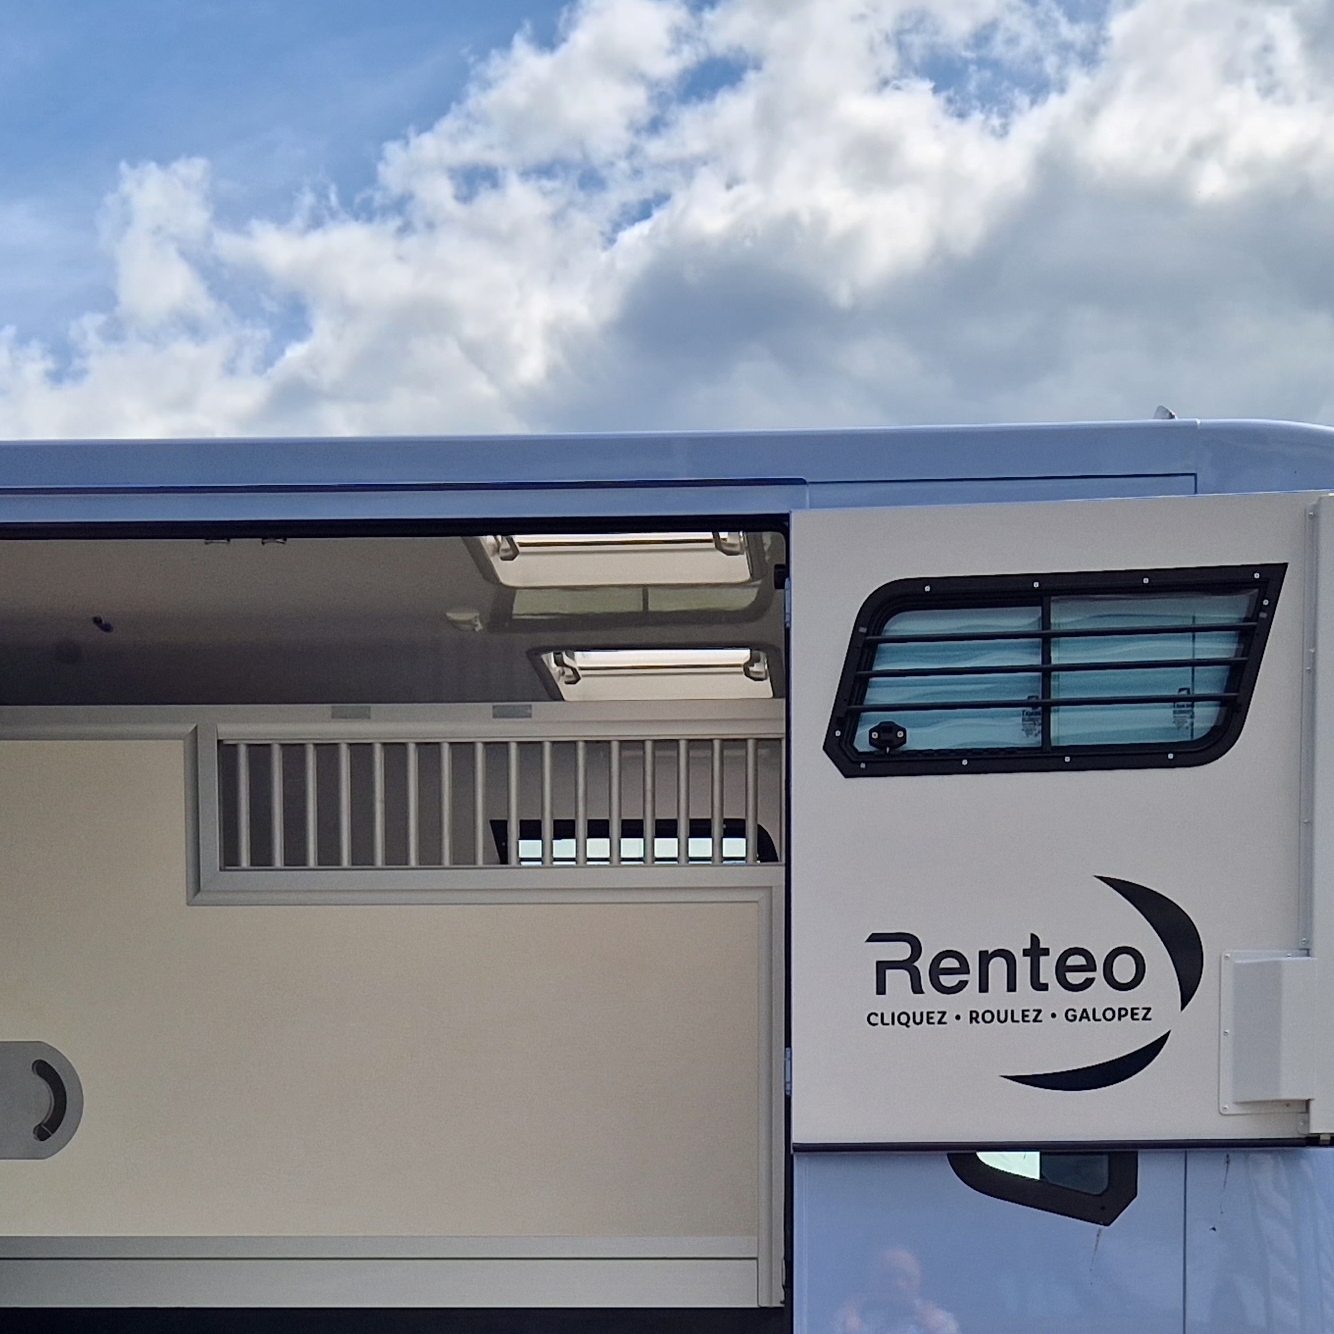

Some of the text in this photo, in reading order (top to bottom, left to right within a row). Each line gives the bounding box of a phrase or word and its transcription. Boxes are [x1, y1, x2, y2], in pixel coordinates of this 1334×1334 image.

[865, 931, 1147, 996] Renteo
[866, 1006, 1153, 1028] CLIQUEZ ROULEZ GALOPEZ
